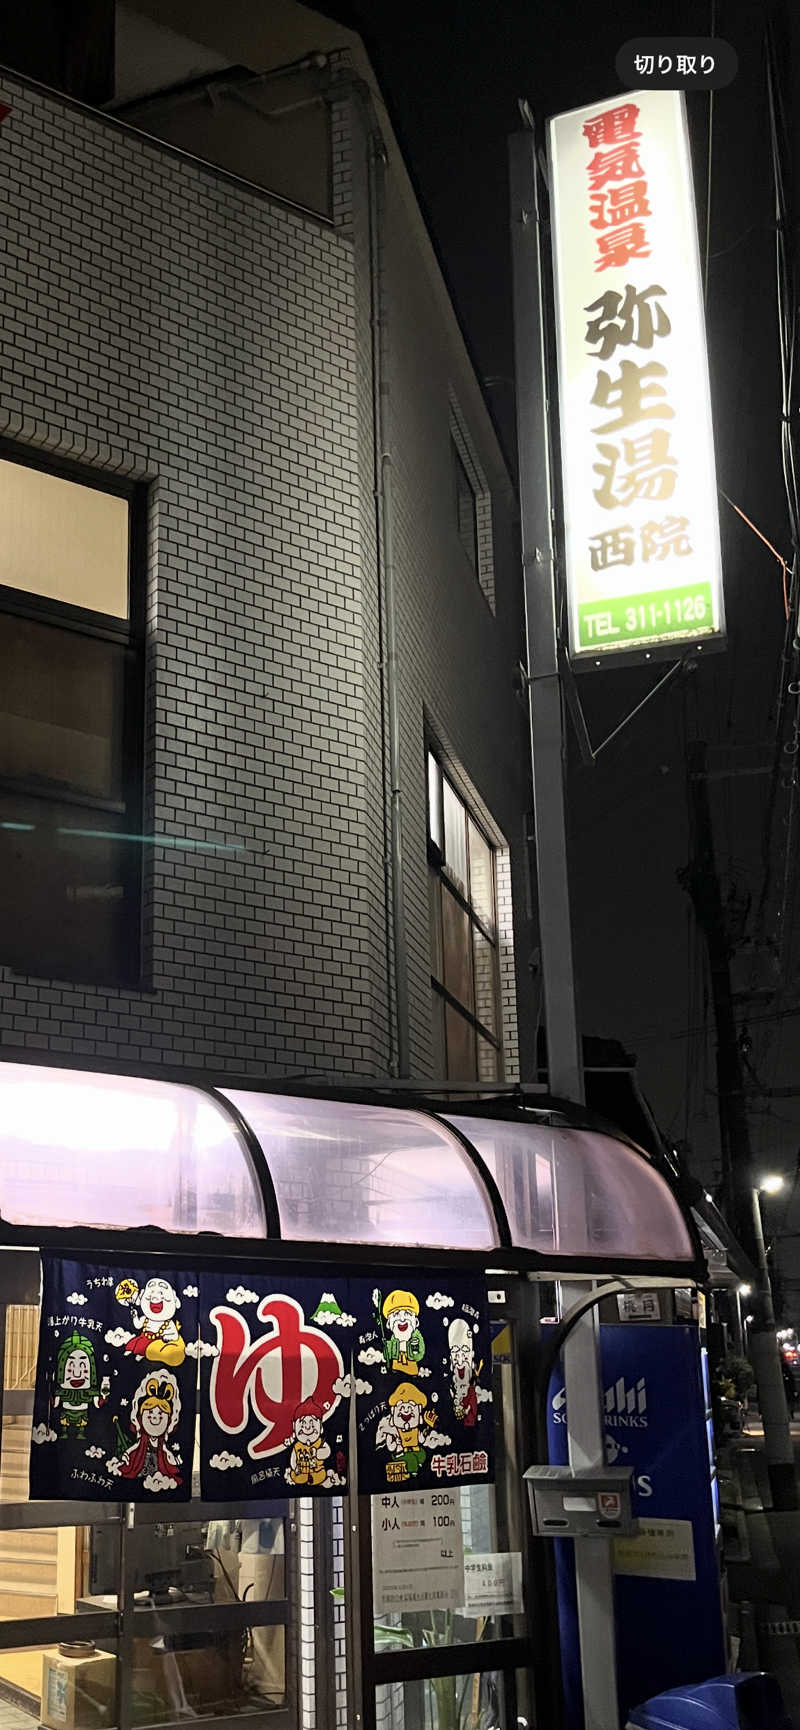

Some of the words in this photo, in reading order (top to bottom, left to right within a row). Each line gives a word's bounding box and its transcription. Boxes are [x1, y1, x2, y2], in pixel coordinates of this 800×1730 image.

[582, 103, 652, 273] 電気温泉
[583, 283, 678, 511] 弥生湯
[588, 515, 693, 572] 西院
[583, 609, 621, 638] TEL
[624, 594, 707, 632] 311-1126
[209, 1293, 344, 1460] ゆ
[381, 1496, 400, 1509] 中人
[381, 1517, 401, 1531] 小人
